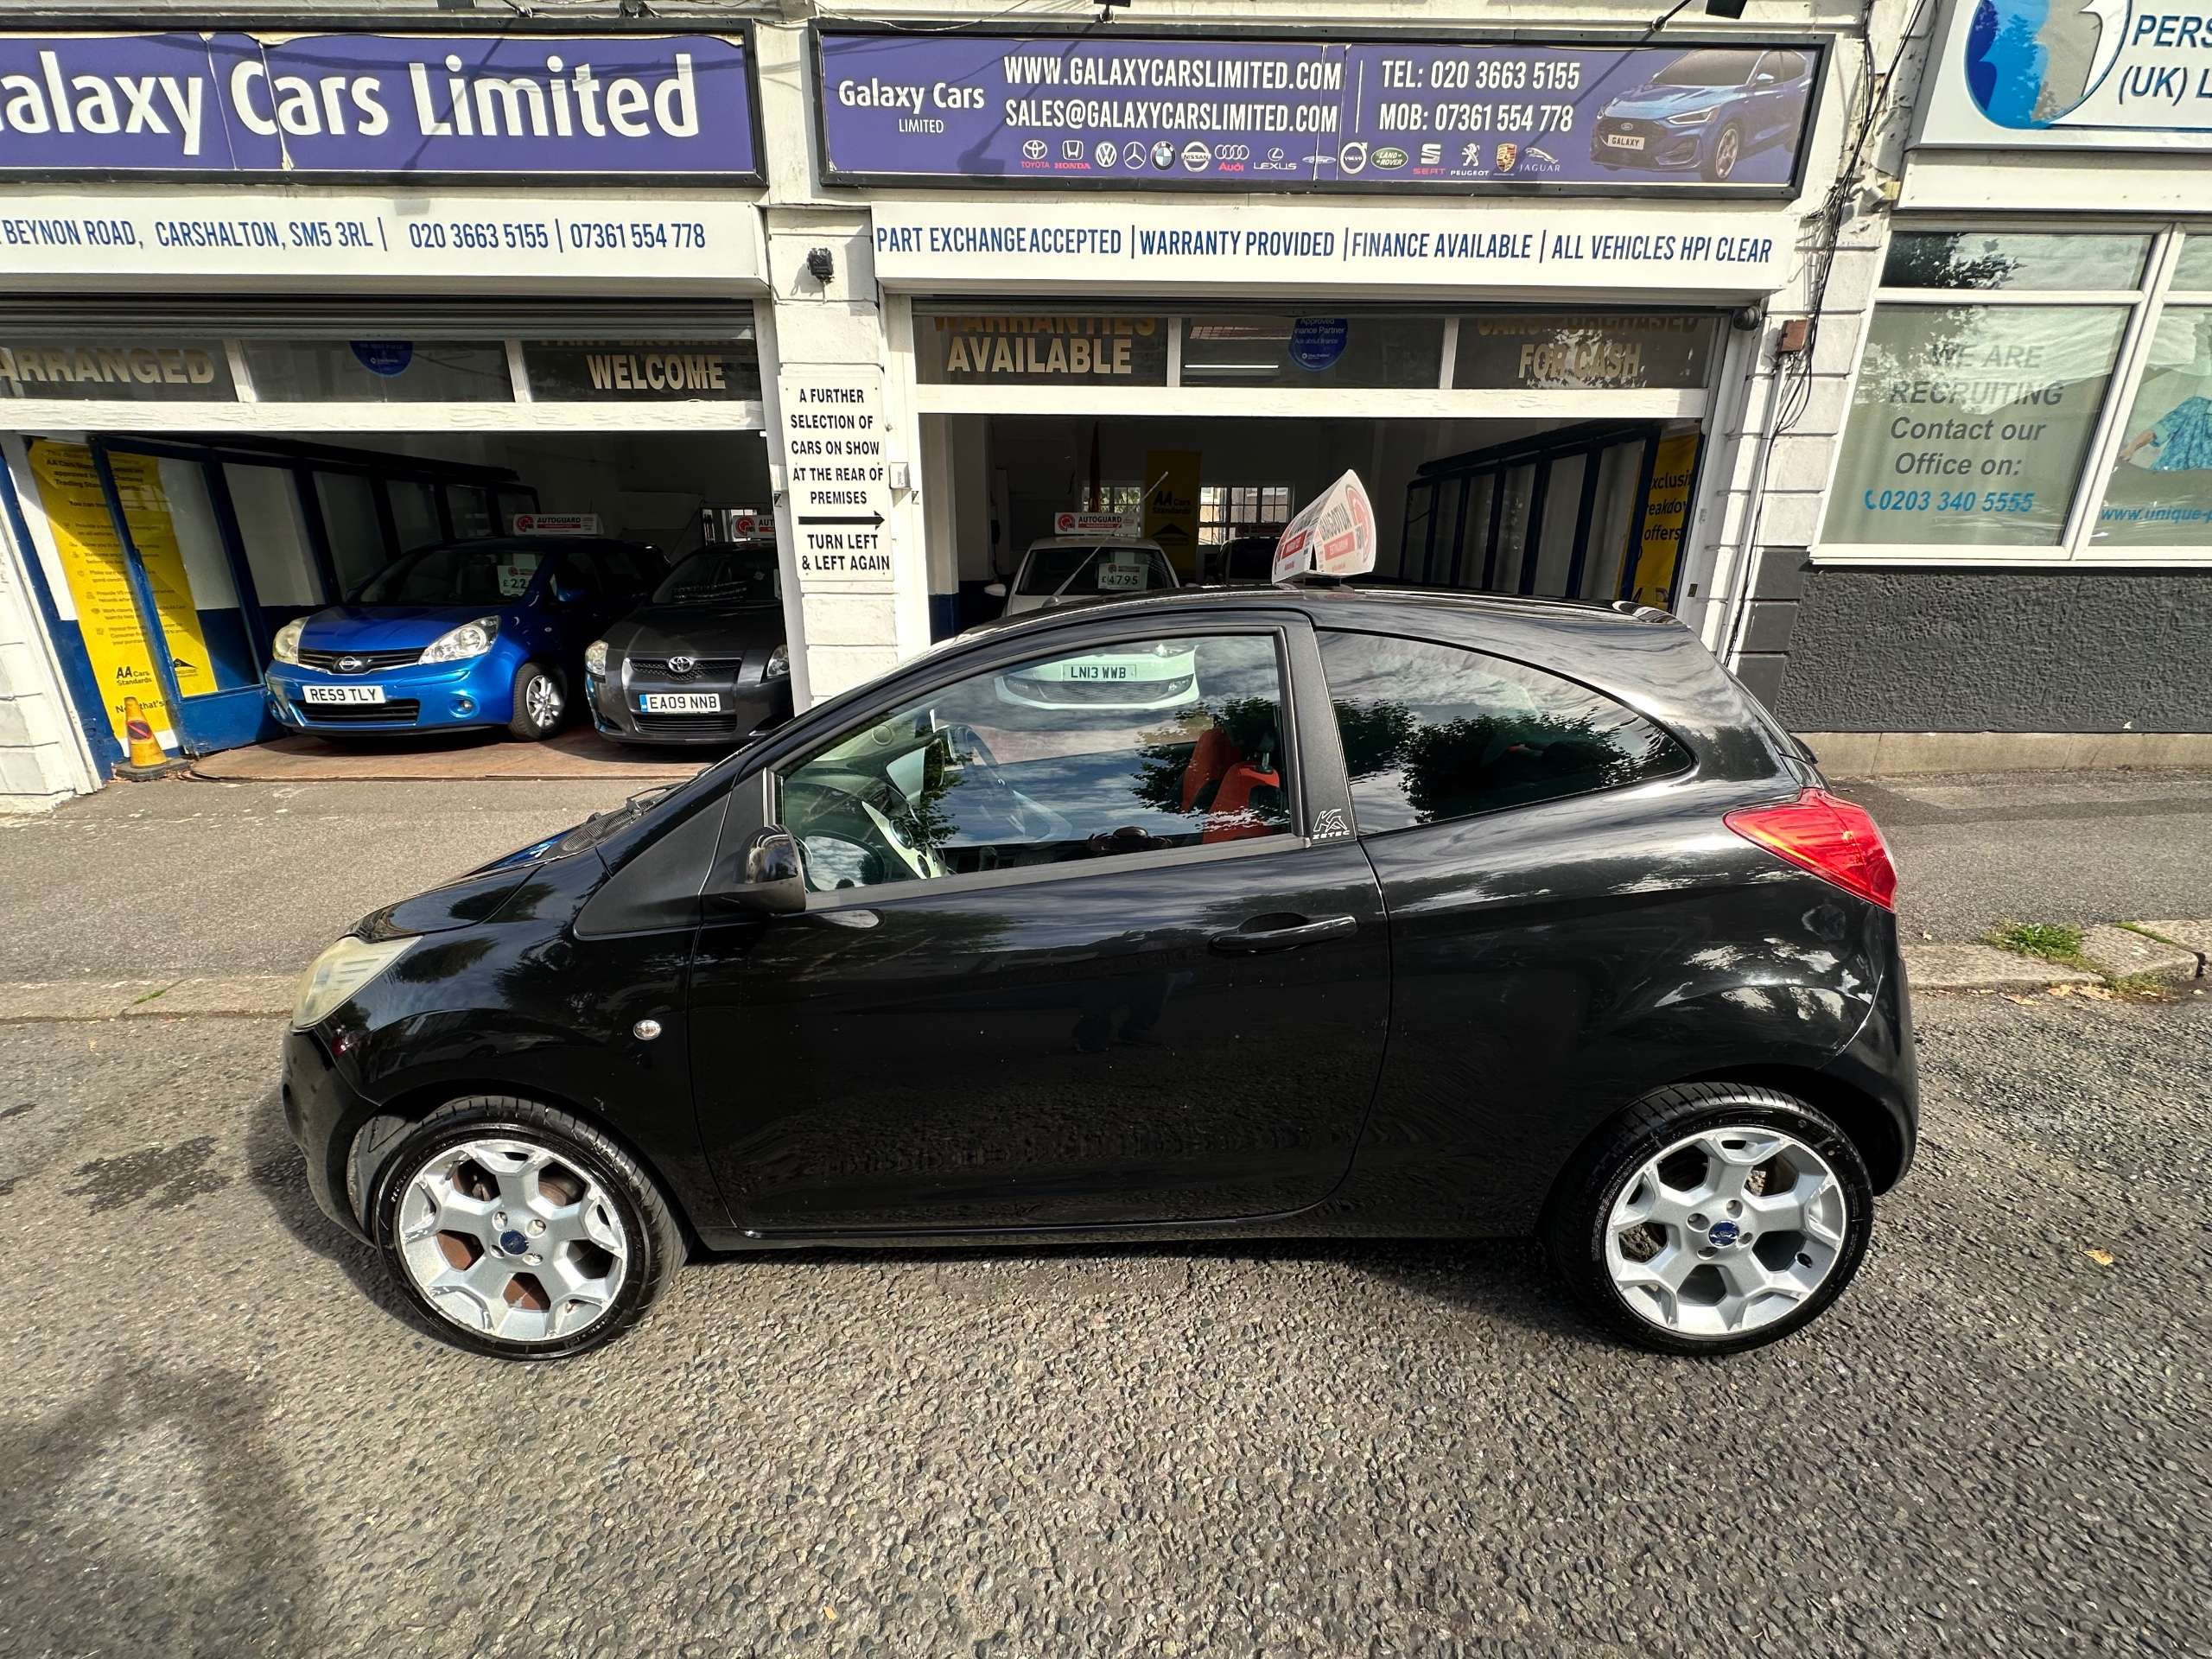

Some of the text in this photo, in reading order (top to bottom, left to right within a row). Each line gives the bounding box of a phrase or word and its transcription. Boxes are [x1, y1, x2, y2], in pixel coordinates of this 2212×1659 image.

[1004, 56, 1341, 91] WWW.GALAXYCARSLIMITED.COM
[1382, 60, 1580, 90] TEL: 020 3663 5155
[2118, 65, 2188, 106] (UK)
[0, 50, 701, 156] alaxy Cars Limited
[838, 78, 985, 113] Galaxy Cars
[1005, 99, 1338, 133] SALES@GALAXYCARSLIMITED.COM
[1379, 104, 1573, 132] MOB: 07361 554 778
[899, 119, 944, 134] LIMITED
[1611, 137, 1640, 146] GALAXY
[1054, 162, 1092, 170] HONDA
[1218, 162, 1244, 171] Audi
[1254, 162, 1297, 170] LEXUS
[1519, 163, 1561, 173] JAGUAR
[2, 219, 706, 251] BEYNON ROAD, CARSHALTON, SM5 3RL 020 3663 5155 07361 554 778
[876, 227, 1773, 263] PART EXCHANGE ACCEPTED WARRANTY PROVIDED FINANCE AVAILABLE ALL VEHICLES HPI CLEAR
[947, 336, 1132, 374] AVAILABLE
[1518, 344, 1640, 379] FOR CASH
[1931, 344, 2045, 368] WE ARE
[586, 353, 727, 390] WELCOME
[799, 388, 864, 404] A FURTHER
[1890, 380, 2065, 406] RECRUITING
[791, 415, 874, 429] SELECTION OF
[1890, 416, 2047, 441] Contact our
[791, 441, 880, 455] CARS ON SHOW
[1894, 452, 2022, 476] Office on:
[793, 467, 806, 481] AT
[810, 467, 832, 481] THE
[836, 467, 866, 481] REAR
[869, 467, 884, 481] OF
[810, 491, 867, 505] PREMISES
[1879, 490, 2035, 512] 0203 340 5555
[807, 534, 879, 550] TURN LEFT
[802, 556, 890, 570] & LEFT AGAIN
[1102, 575, 1138, 585] £4795
[116, 666, 132, 679] AA
[1071, 666, 1127, 679] LN13 WWB
[117, 677, 153, 686] Standards
[309, 688, 376, 702] RE59 TLY
[650, 696, 717, 709] EA09 NNB
[1313, 830, 1351, 840] ZETEC
